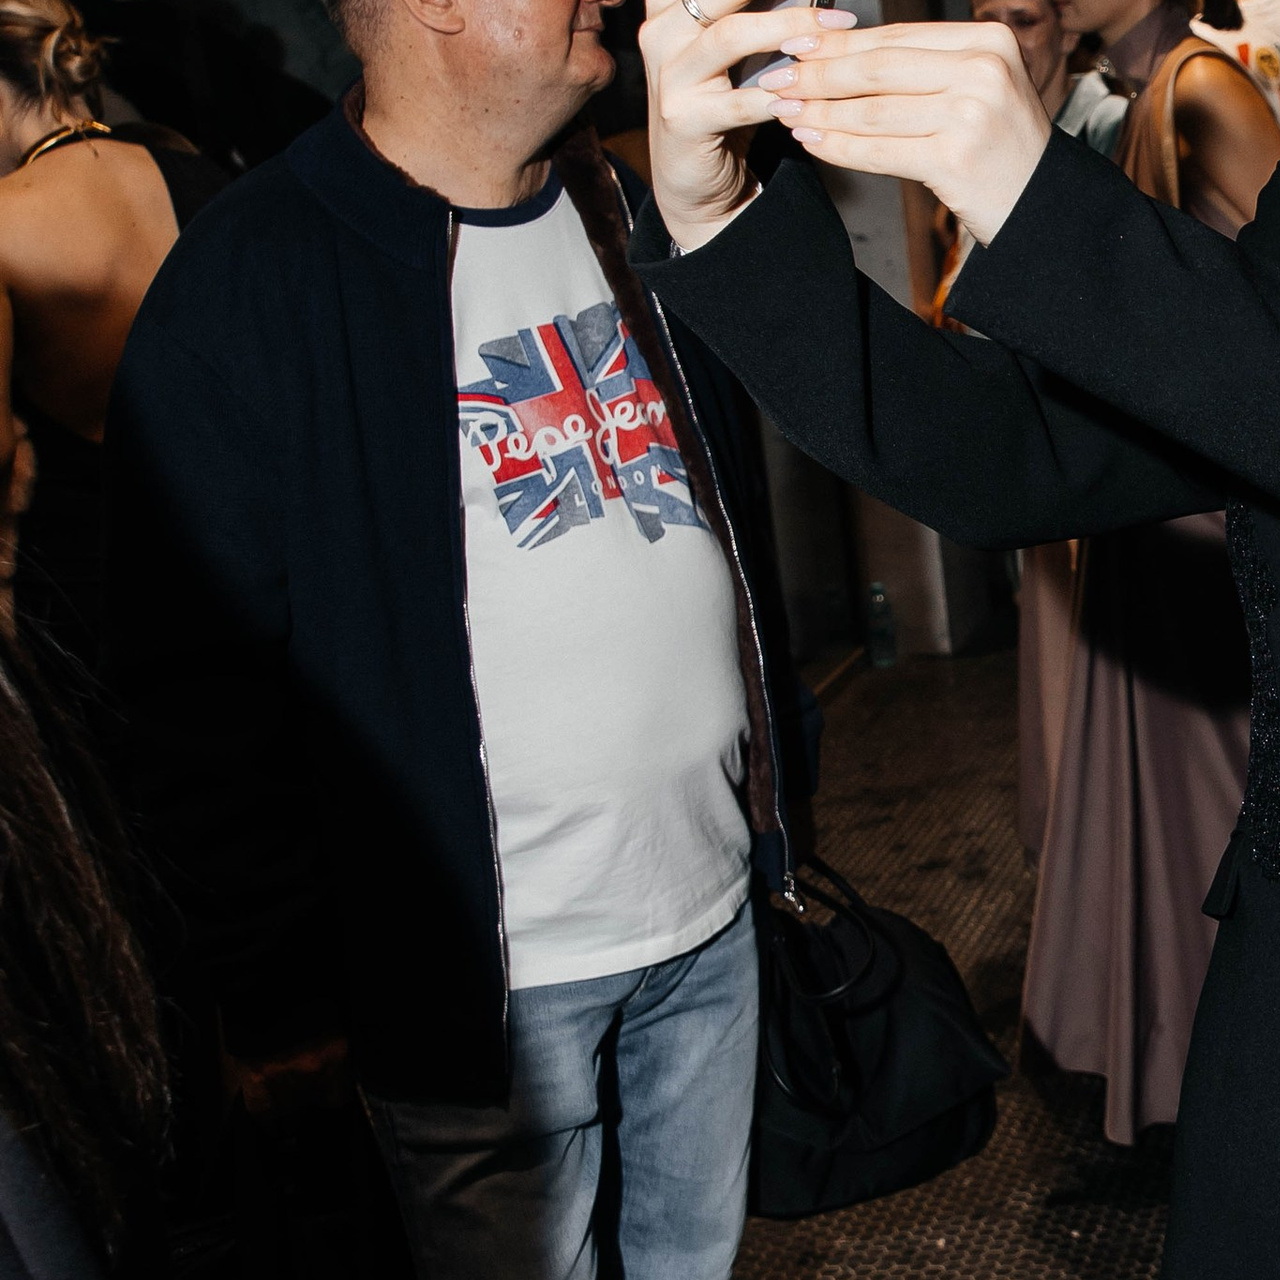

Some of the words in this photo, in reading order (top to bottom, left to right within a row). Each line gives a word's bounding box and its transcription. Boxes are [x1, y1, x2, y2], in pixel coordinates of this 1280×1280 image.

[466, 411, 593, 486] Pepe
[586, 389, 668, 466] Jean
[574, 464, 666, 508] LONDON
